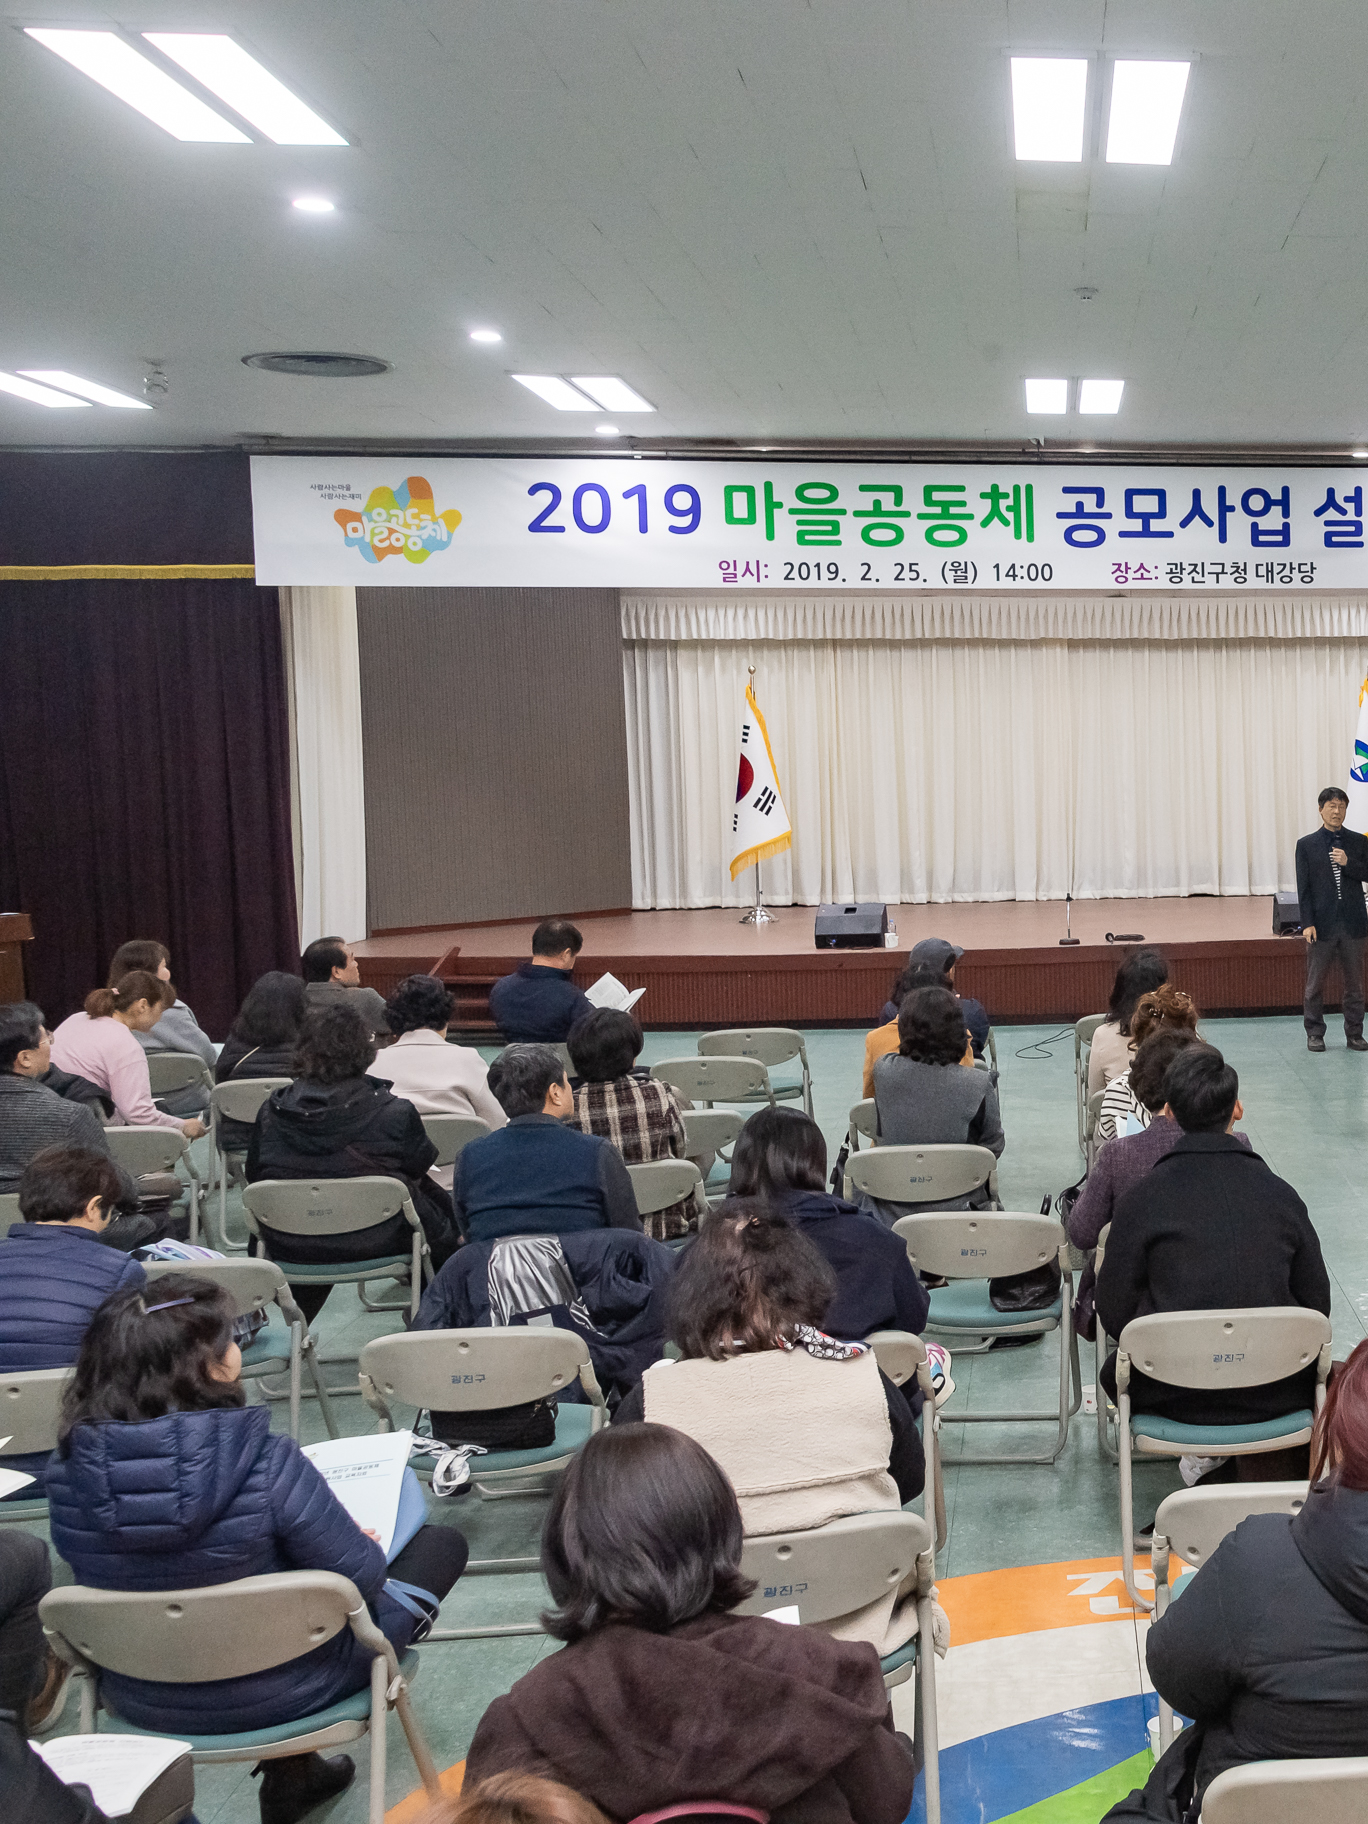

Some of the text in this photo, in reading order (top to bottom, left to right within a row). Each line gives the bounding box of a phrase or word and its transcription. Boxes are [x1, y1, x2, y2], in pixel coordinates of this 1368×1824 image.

[527, 482, 701, 534] 2019
[723, 481, 1035, 548] 마을공동체
[1056, 485, 1291, 548] 공모사업
[718, 560, 1317, 585] 일시: 2019. 2. 25. (월) 14:00 장소: 광진구청 대강당
[960, 1249, 987, 1257] 광진구
[1213, 1353, 1245, 1363] 광진구
[451, 1374, 486, 1385] 광진구
[763, 1582, 808, 1598] 광진구
